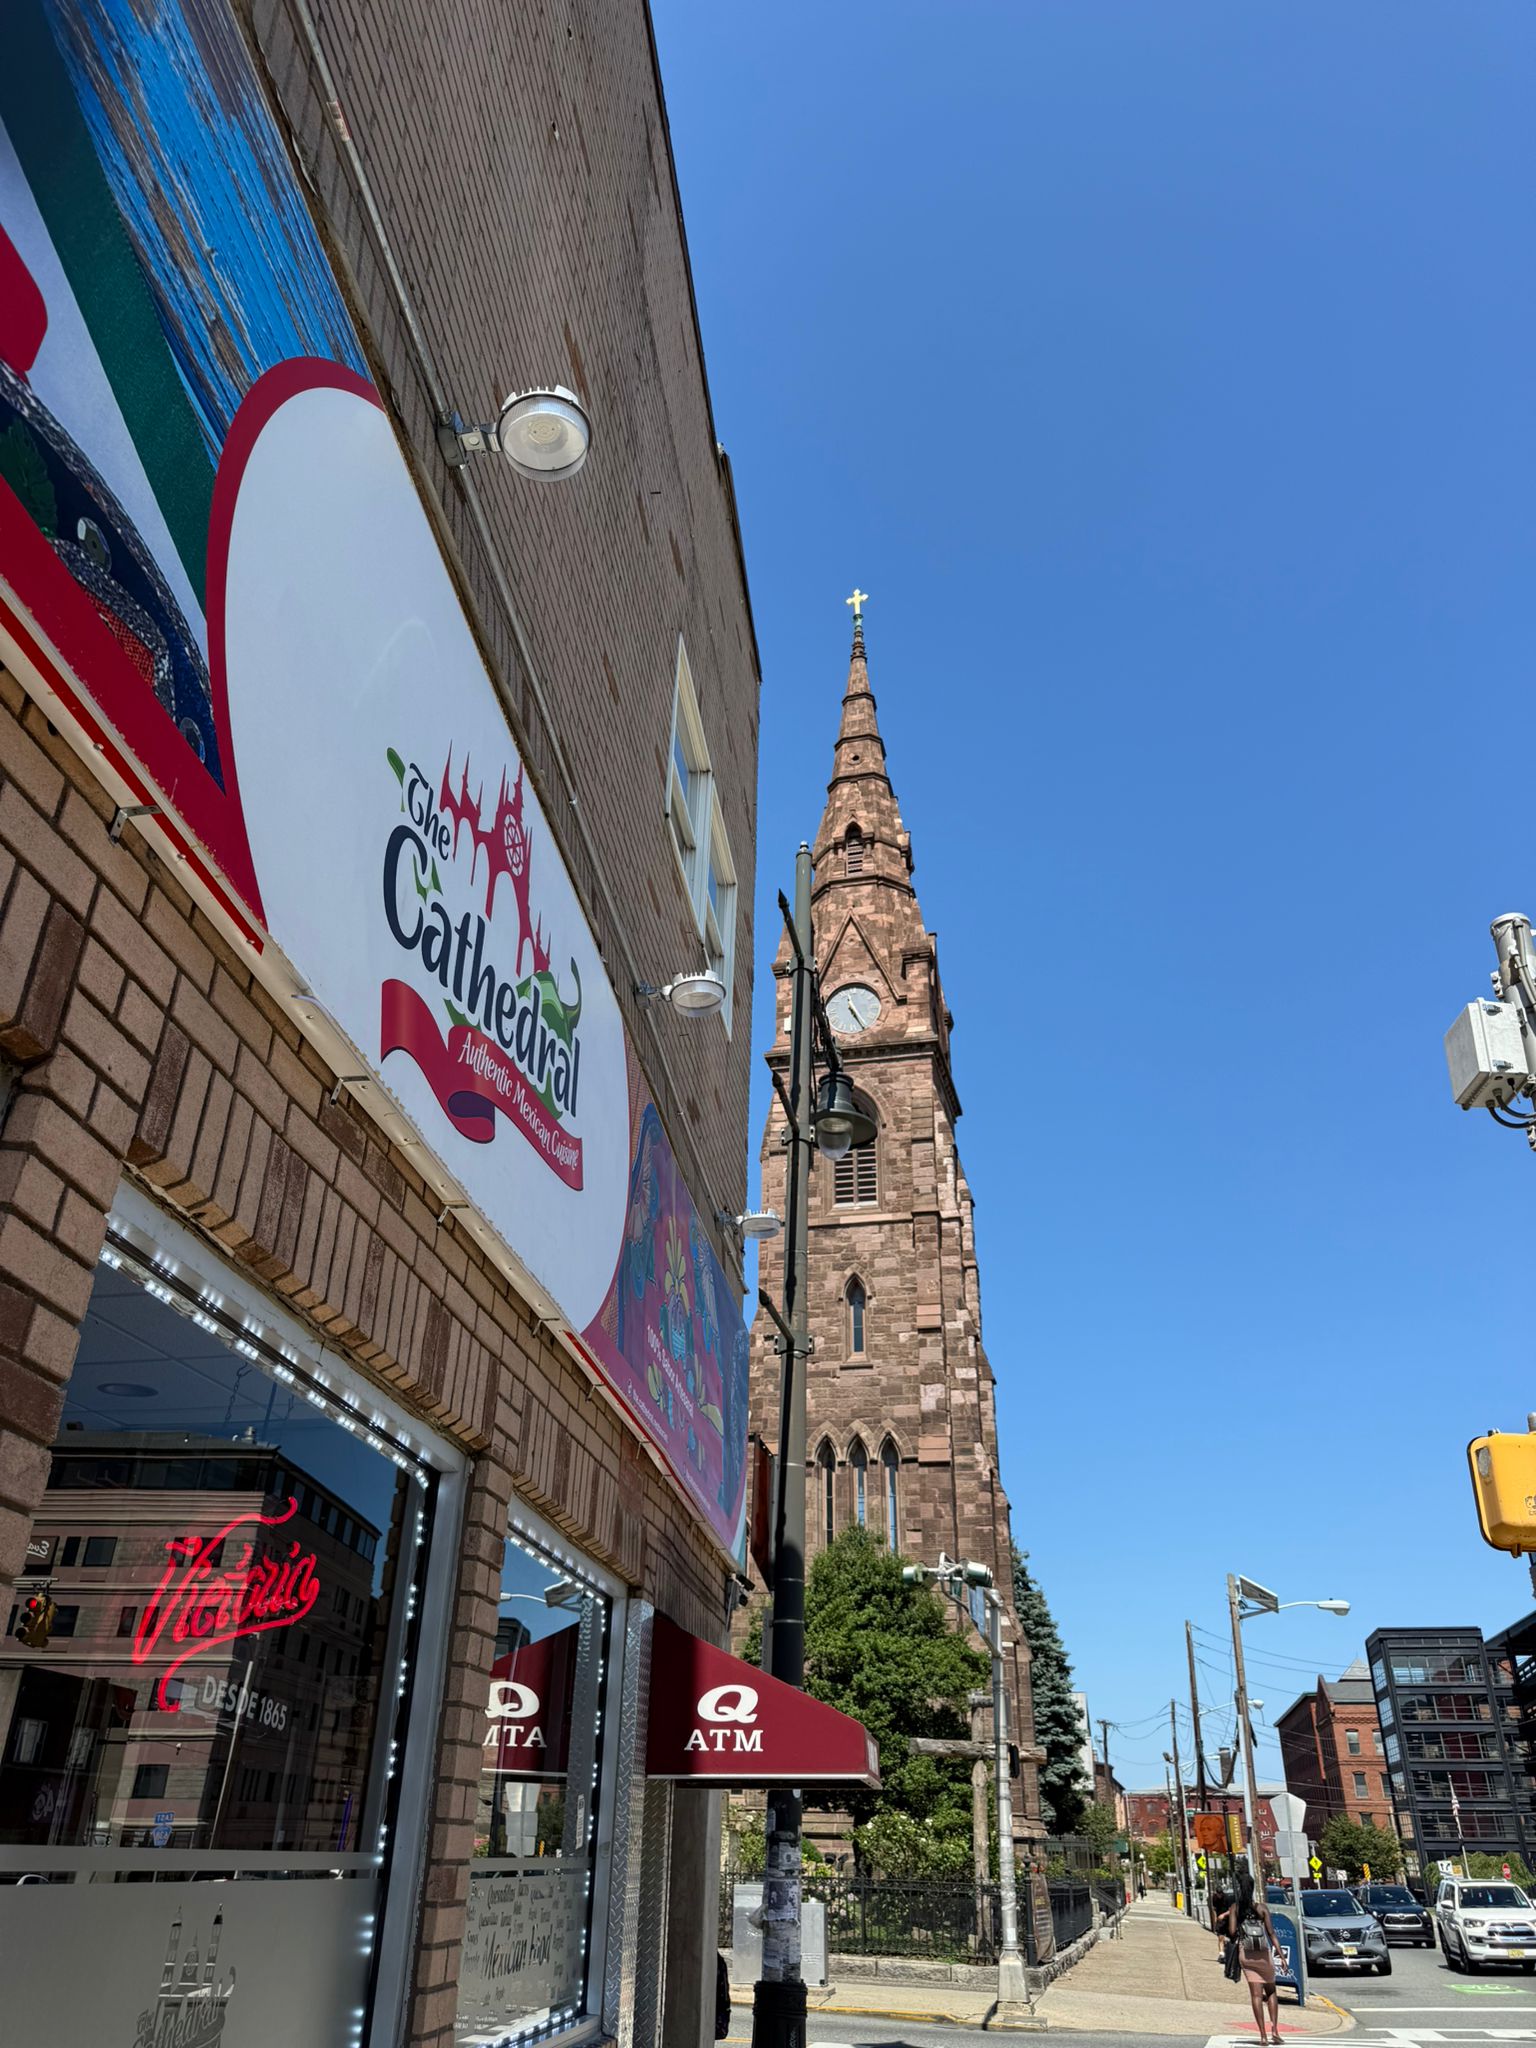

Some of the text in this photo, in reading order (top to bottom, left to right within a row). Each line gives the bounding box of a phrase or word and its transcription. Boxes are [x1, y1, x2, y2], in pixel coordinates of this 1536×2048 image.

[408, 762, 450, 861] The
[383, 824, 581, 1118] Cathedral
[458, 1032, 579, 1170] Authentic Mexican Cuisine
[131, 1497, 320, 1712] Victoria
[203, 1675, 289, 1732] DESDE 1865
[684, 1728, 764, 1752] ATM
